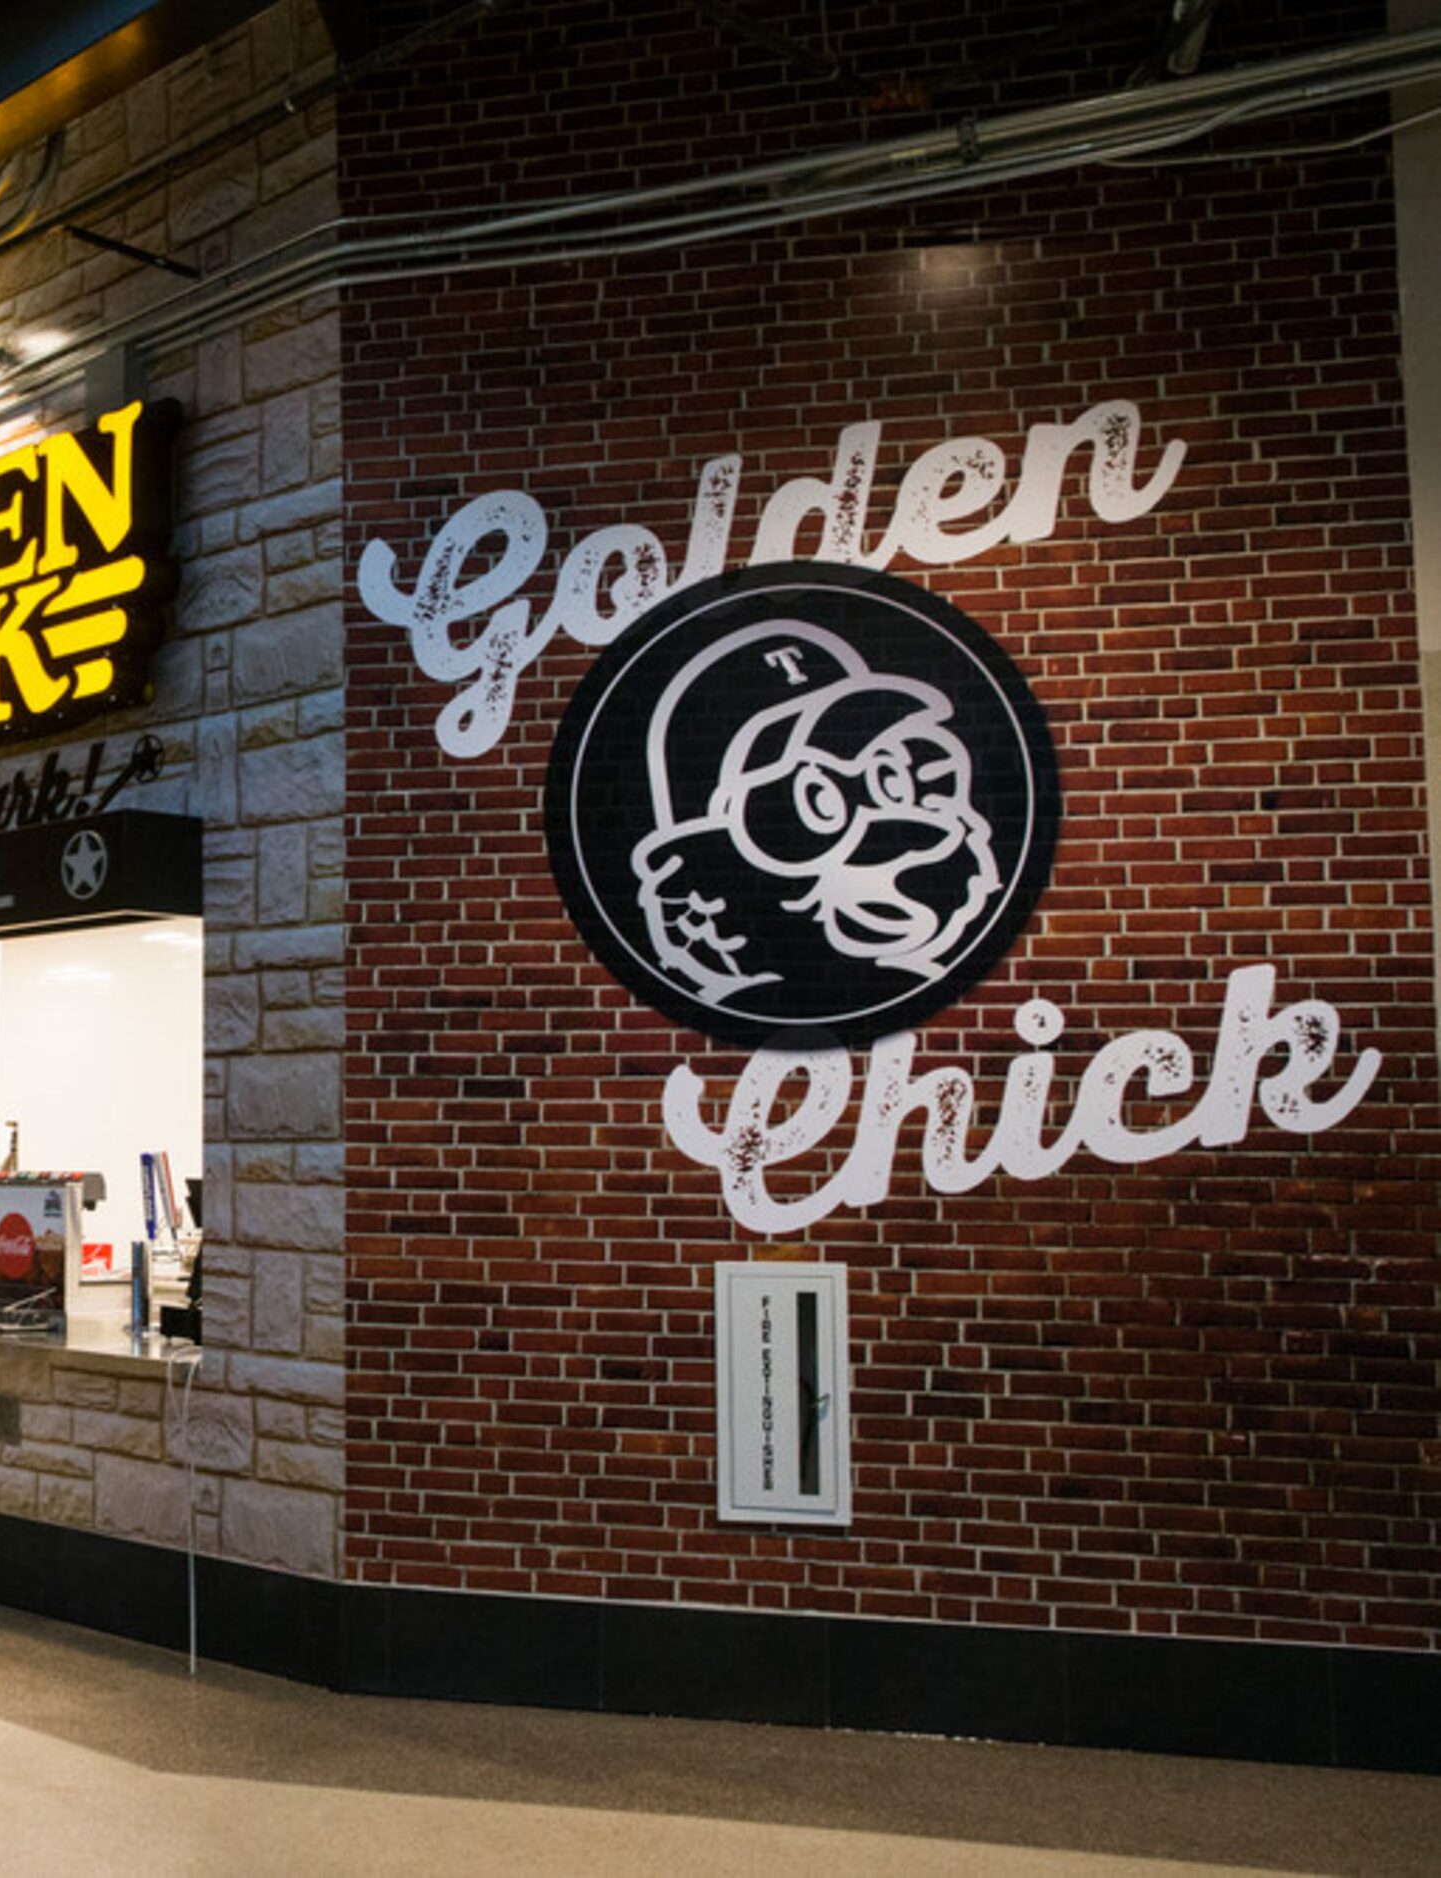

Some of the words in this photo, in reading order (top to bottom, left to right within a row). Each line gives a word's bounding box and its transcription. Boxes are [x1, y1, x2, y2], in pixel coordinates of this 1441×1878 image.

[358, 400, 1188, 758] Golden
[764, 646, 808, 685] T
[663, 964, 1382, 1234] Chick
